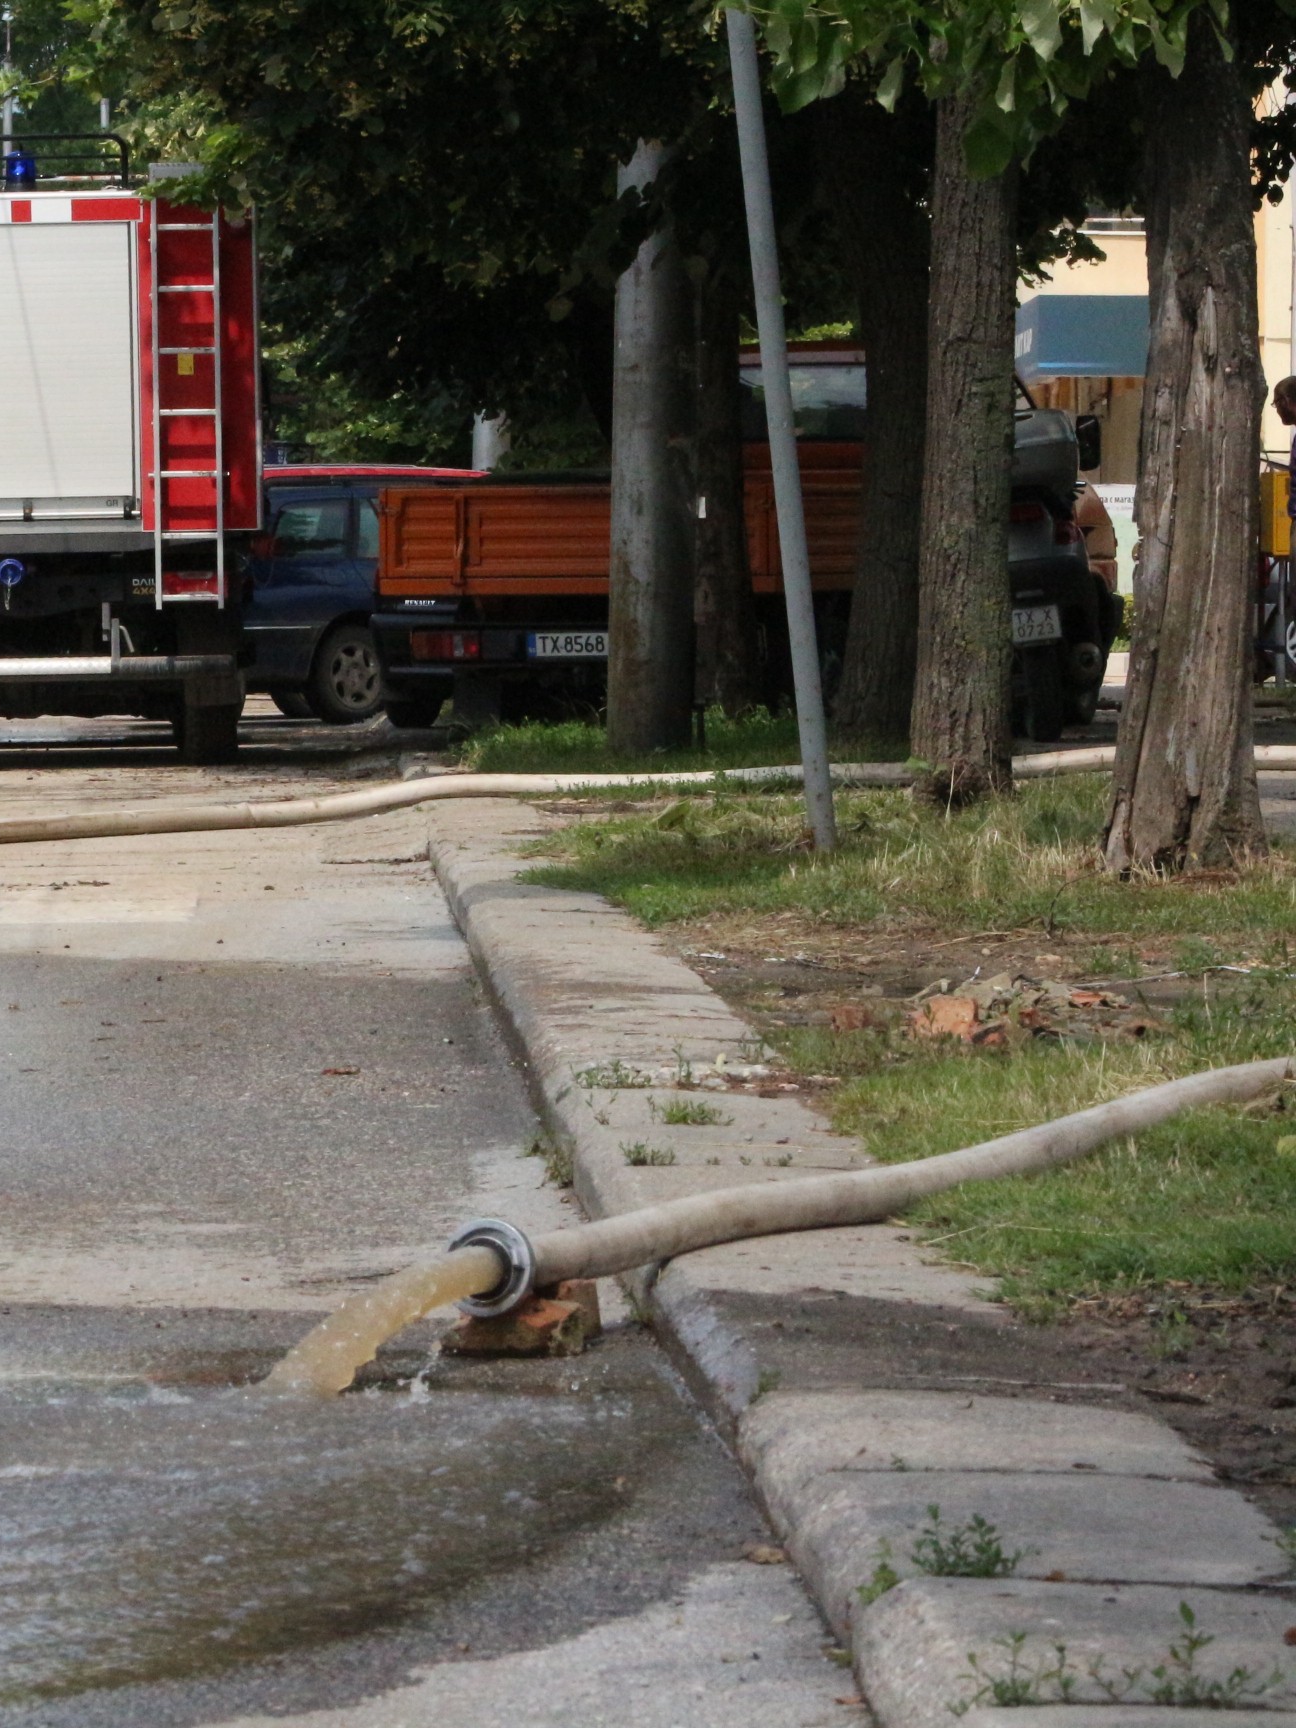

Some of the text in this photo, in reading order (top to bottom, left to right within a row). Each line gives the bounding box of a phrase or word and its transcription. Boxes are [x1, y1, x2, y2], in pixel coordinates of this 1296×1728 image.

[132, 578, 156, 586] DAIL
[1017, 622, 1055, 638] 0723
[538, 635, 605, 654] TX 8568
